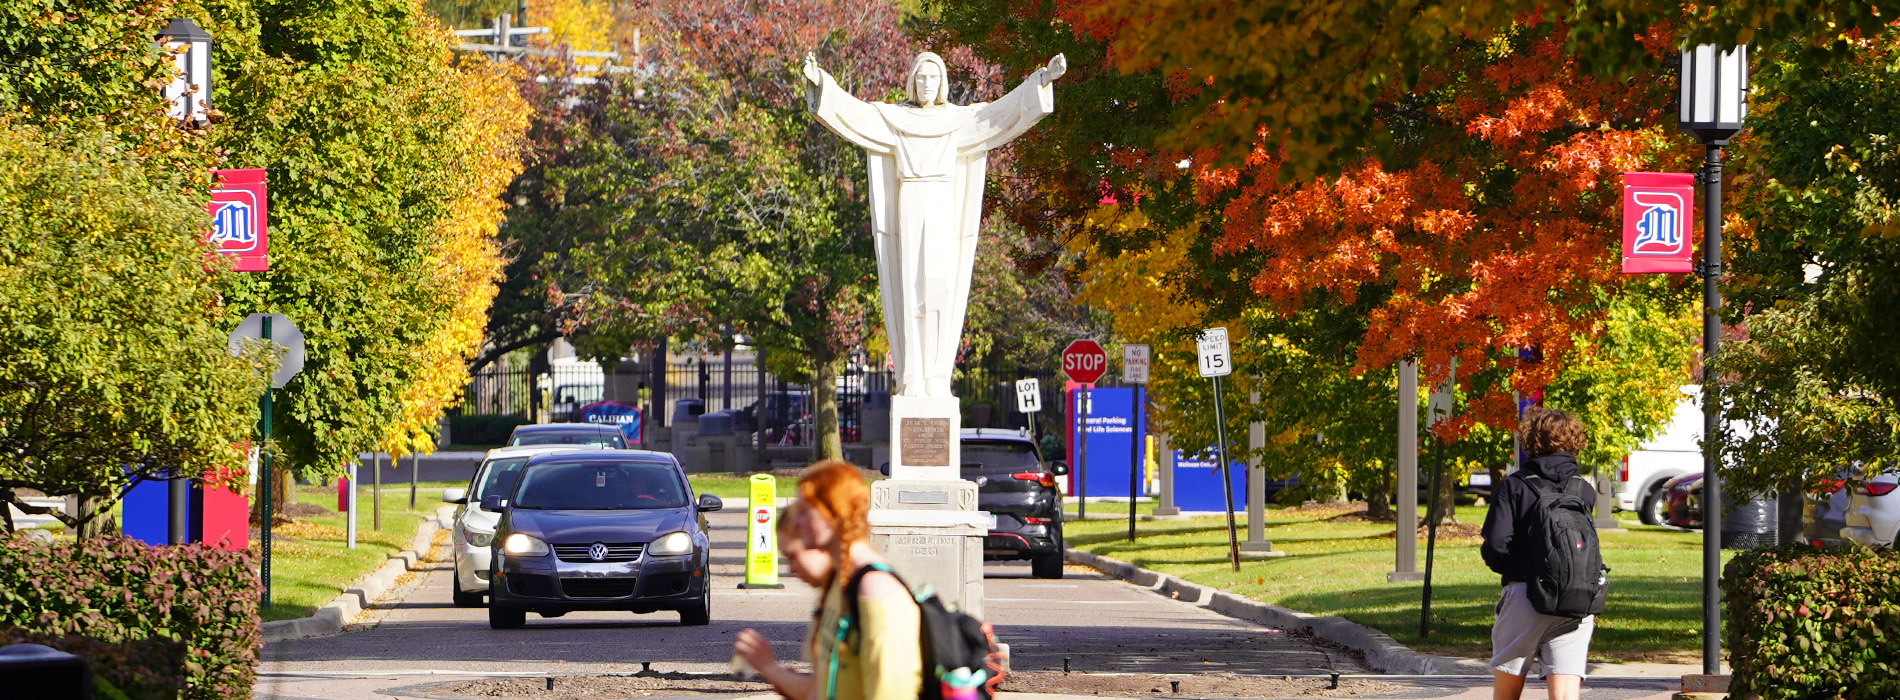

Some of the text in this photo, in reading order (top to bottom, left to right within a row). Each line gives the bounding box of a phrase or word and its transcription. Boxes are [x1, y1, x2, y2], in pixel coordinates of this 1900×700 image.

[1202, 343, 1223, 351] LIMIT
[1131, 349, 1141, 357] NO
[1065, 353, 1104, 371] STOP
[1125, 358, 1147, 366] PARKING
[1205, 354, 1224, 369] 15
[1018, 382, 1036, 393] LOT
[1023, 393, 1036, 408] H
[588, 414, 634, 424] CALIHAN
[1077, 416, 1127, 425] Gneral Parking
[1092, 425, 1106, 433] Life
[1105, 425, 1133, 433] Sciences
[755, 512, 770, 521] STOP
